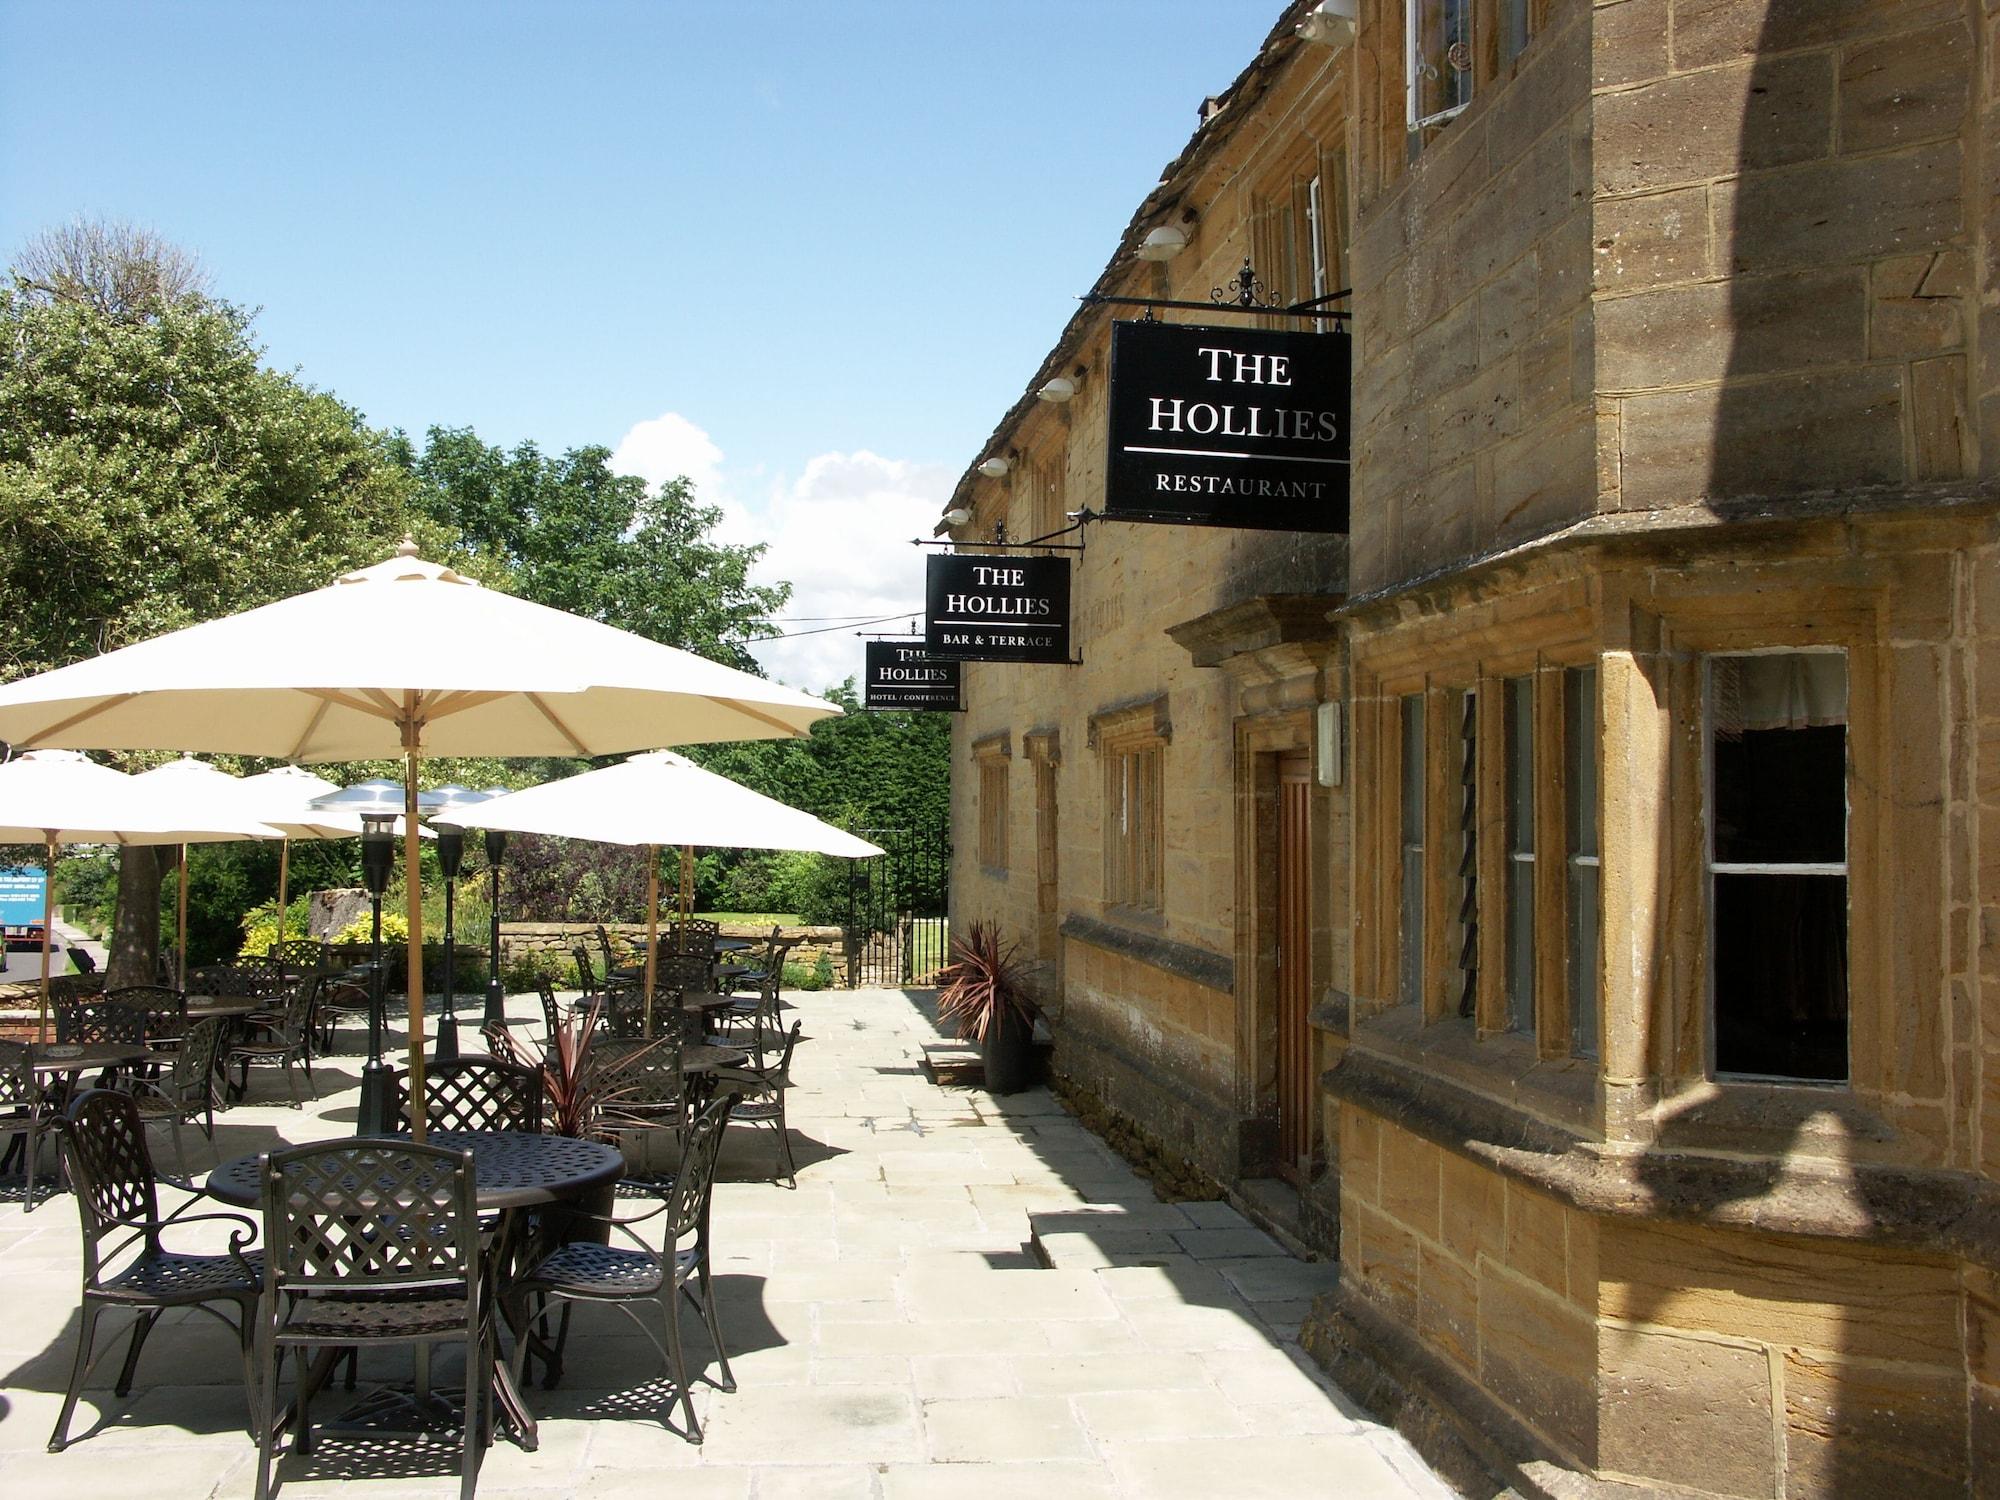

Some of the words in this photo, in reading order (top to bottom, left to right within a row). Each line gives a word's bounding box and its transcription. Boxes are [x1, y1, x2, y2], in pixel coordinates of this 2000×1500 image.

[1198, 347, 1292, 387] THE
[1147, 397, 1338, 443] HOLLIES
[1155, 473, 1327, 500] RESTAURANT
[972, 566, 1025, 587] THE
[946, 594, 1050, 616] HOLLIES
[943, 634, 970, 645] BAR
[974, 634, 985, 646] &
[989, 635, 1053, 647] TERRACE
[879, 667, 948, 681] HOLLIES
[870, 693, 898, 702] HOTEL
